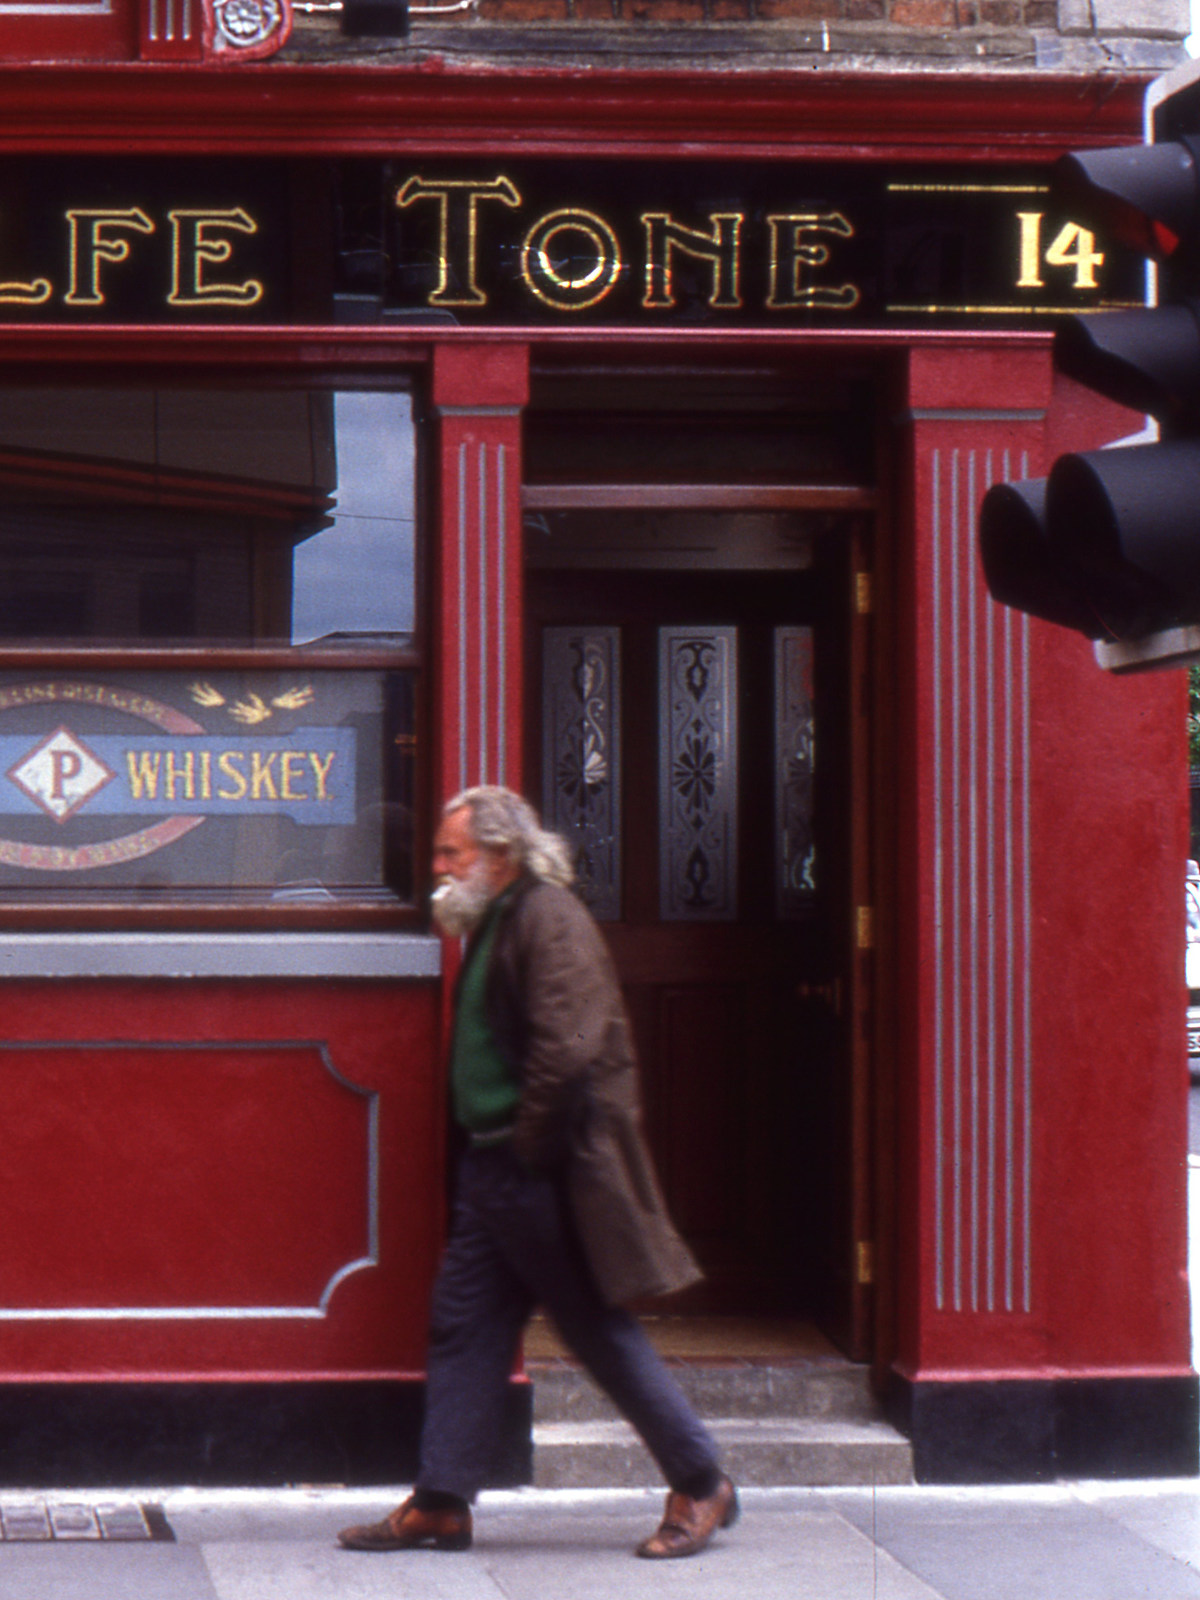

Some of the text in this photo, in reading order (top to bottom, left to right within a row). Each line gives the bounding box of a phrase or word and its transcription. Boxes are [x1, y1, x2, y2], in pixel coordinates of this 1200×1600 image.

[396, 175, 860, 310] TONE
[1016, 211, 1104, 288] 14
[49, 749, 82, 801] P
